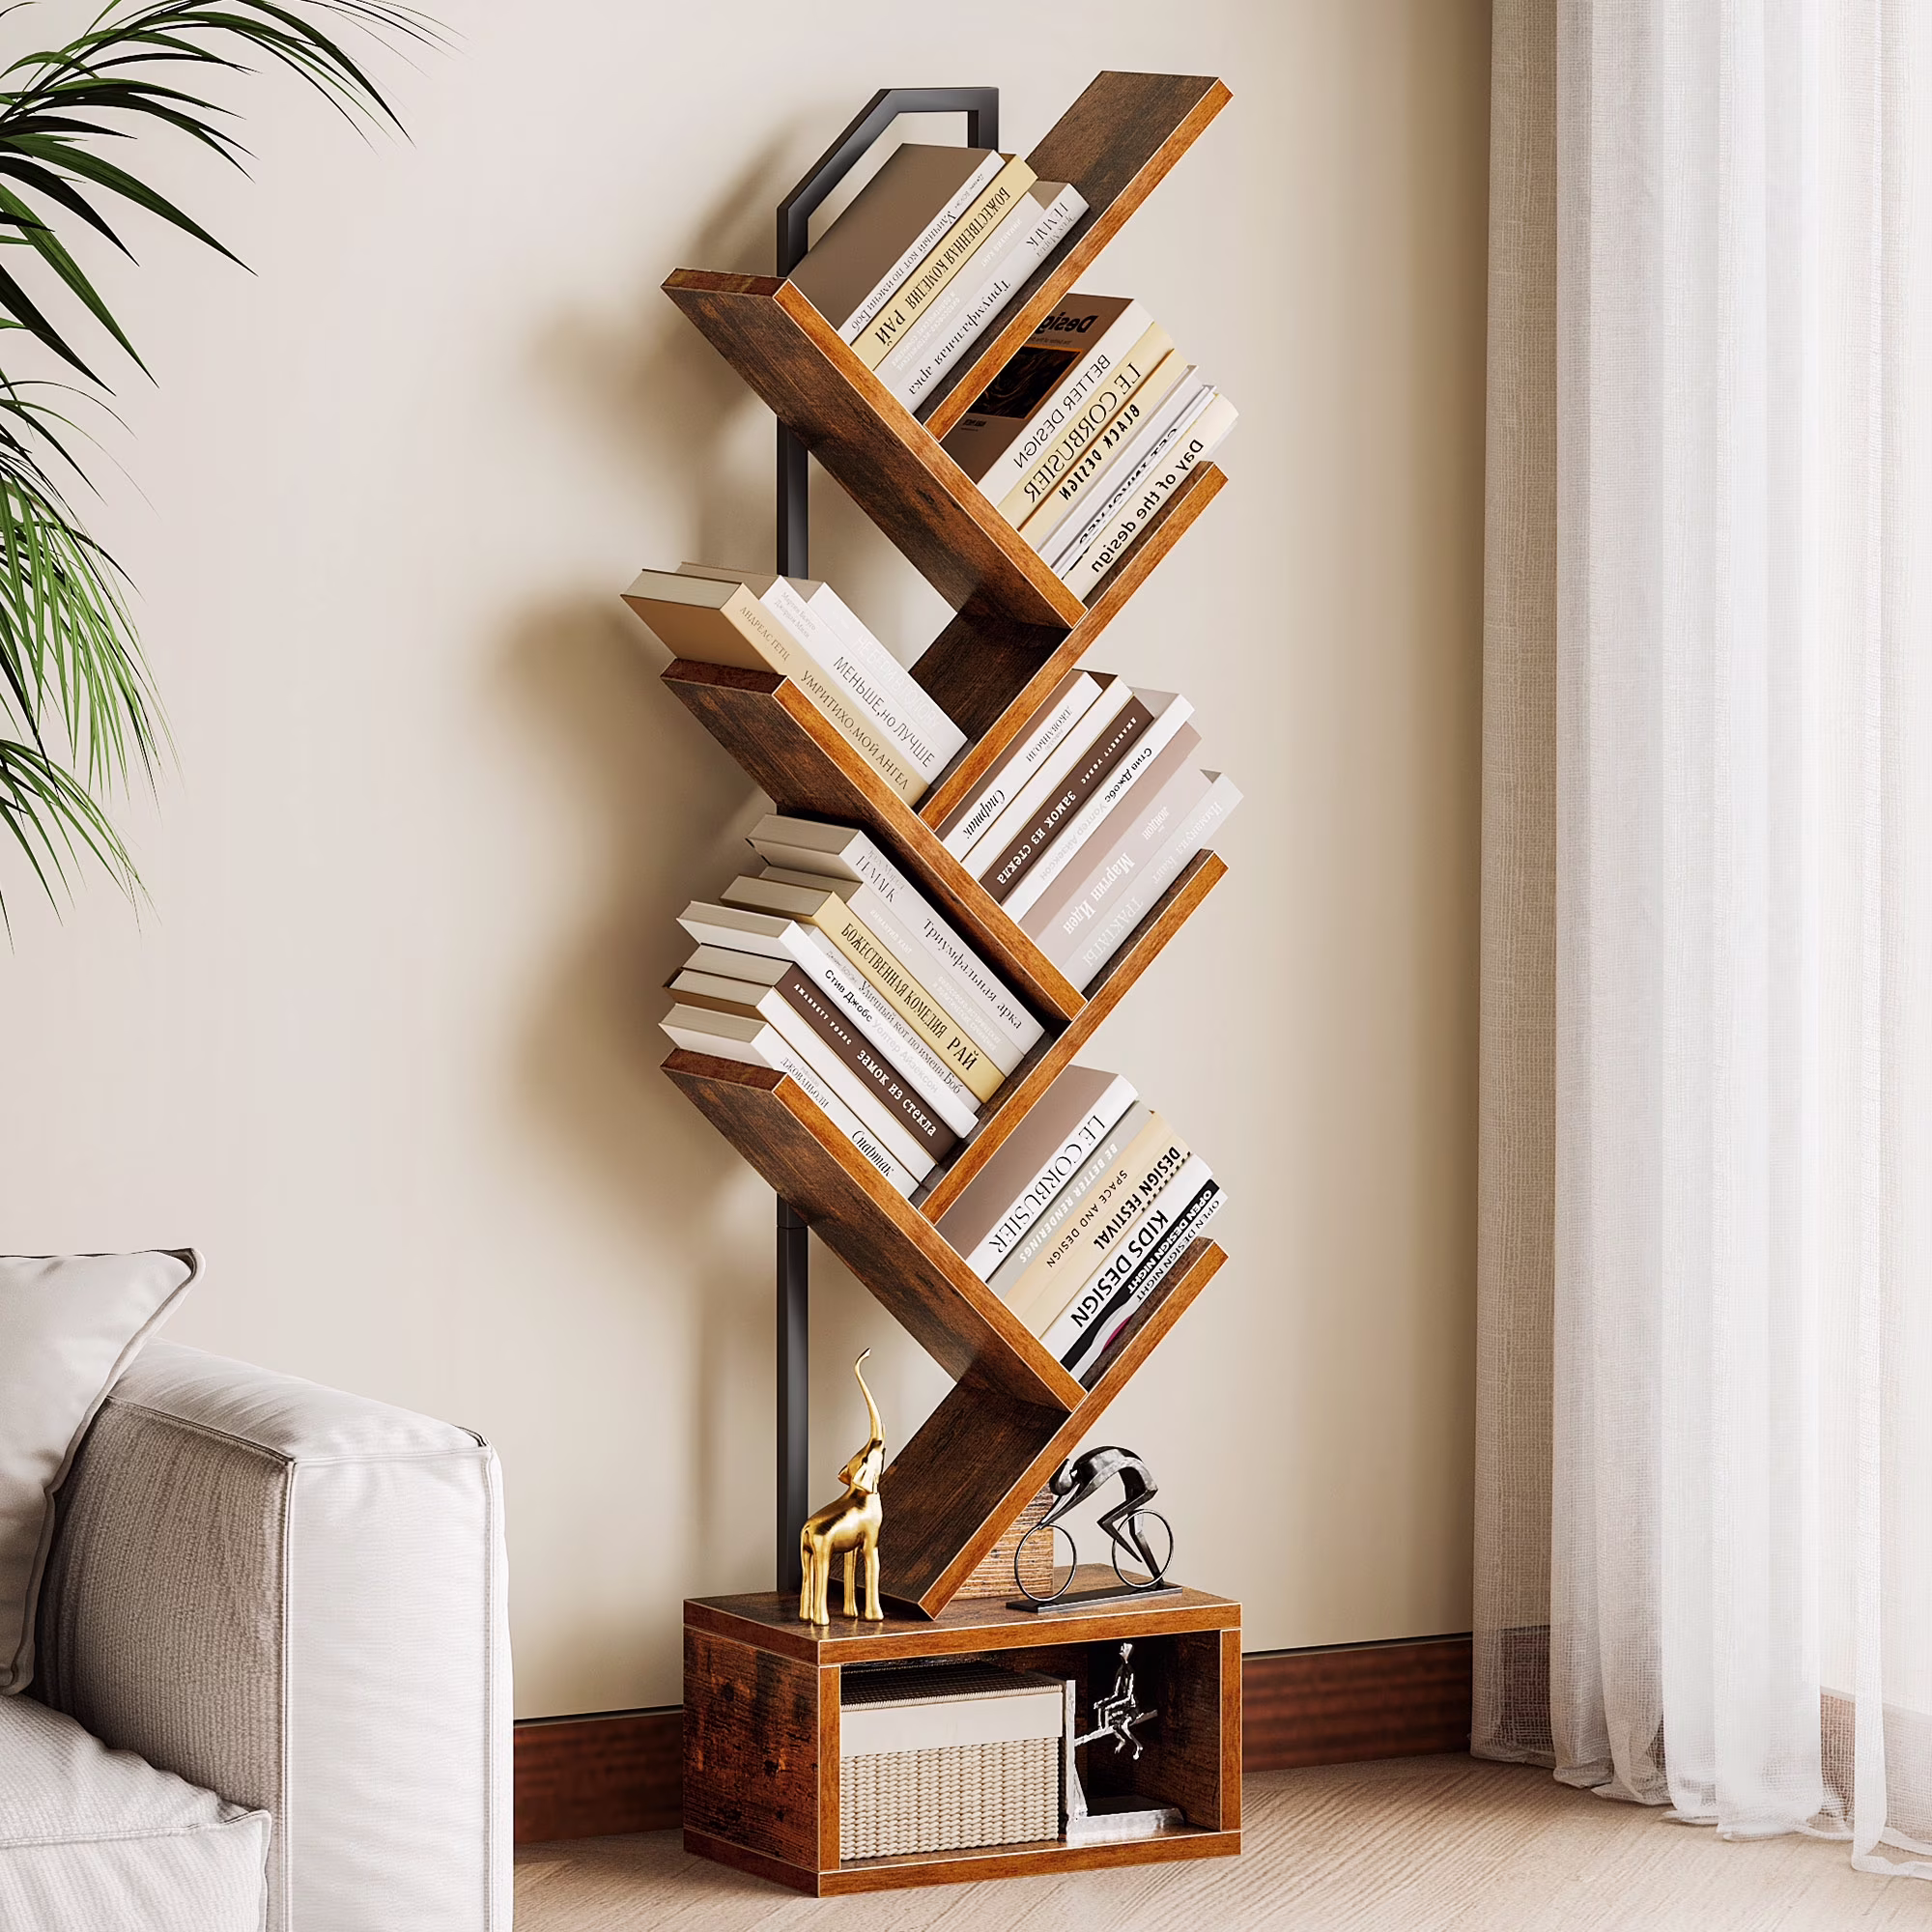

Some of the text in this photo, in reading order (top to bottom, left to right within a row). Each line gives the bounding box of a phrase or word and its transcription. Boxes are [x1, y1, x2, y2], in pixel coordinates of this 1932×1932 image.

[852, 211, 957, 332] Уличный кот по имени Боб
[874, 186, 1011, 347] БОЖЕСТВЕННАЯ КОМЕДИЯ РАЙ
[934, 280, 1011, 366] Триумфальная
[909, 366, 932, 395] арка
[740, 607, 791, 662] АНДРЕАС ГЕТЦ
[875, 754, 909, 790] АНГЕЛ
[894, 723, 935, 768] ЛУЧШЕ
[1105, 748, 1152, 803] Стив Джобс
[963, 790, 1006, 839] Спартак
[1031, 828, 1046, 845] из
[1037, 800, 1109, 884] Уолтер Айзексон
[1044, 790, 1077, 829] замок
[997, 844, 1032, 885] стекла
[1063, 852, 1135, 935] Мартин Иден
[1079, 893, 1146, 969] ТРАКТАТЫ
[825, 970, 872, 1023] Стив Джобс
[841, 923, 980, 1071] БОЖЕСТВЕННАЯ КОМЕДИЯ РАЙ
[923, 919, 1022, 1030] Триумфальная арка
[855, 979, 966, 1096] Уличный кот по имени Боб
[868, 1018, 943, 1095] Уолтер Айзексон
[779, 1055, 832, 1110] ДЖОВАНЬОЛИ
[857, 1050, 937, 1137] замок из стекла
[989, 1115, 1106, 1254] LE CORBUSIER
[1019, 1144, 1119, 1264] BE BETTER RENDERINGS
[1046, 1170, 1128, 1268] SPACE AND DESIGN
[1094, 1147, 1181, 1250] DESIGN FESTIVAL
[1070, 1209, 1169, 1328] KIDS DESIGN
[1127, 1186, 1214, 1294] OPEN DESIGN NIGHT
[1137, 1201, 1220, 1303] OPEN DESIGN NIGHT
